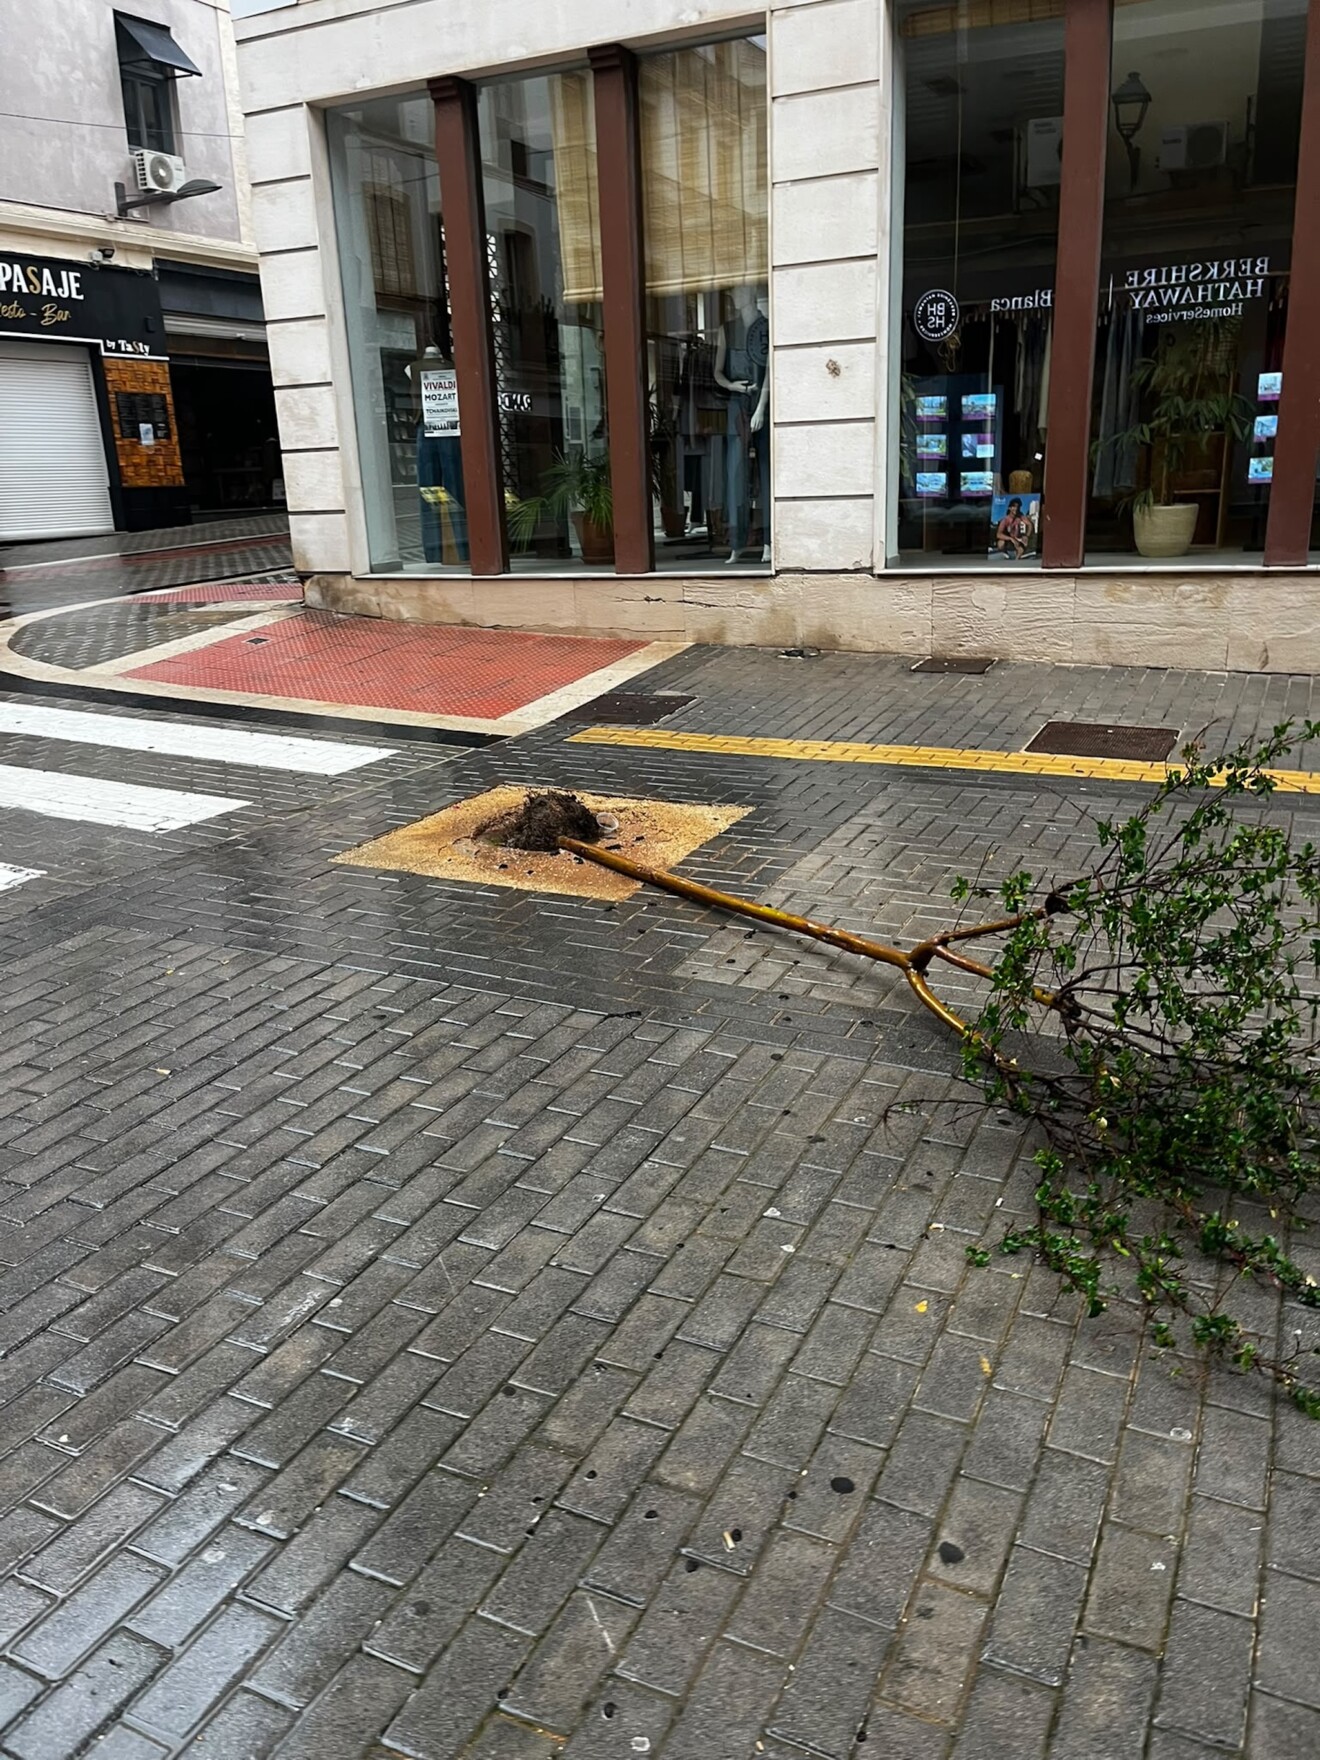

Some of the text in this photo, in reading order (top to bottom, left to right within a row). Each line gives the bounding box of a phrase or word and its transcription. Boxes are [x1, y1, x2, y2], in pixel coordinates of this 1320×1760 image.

[0, 262, 84, 300] PASAJE
[0, 300, 27, 318] esto
[40, 303, 72, 326] Bar
[423, 380, 456, 390] VIVALDI
[424, 392, 456, 401] MOZART
